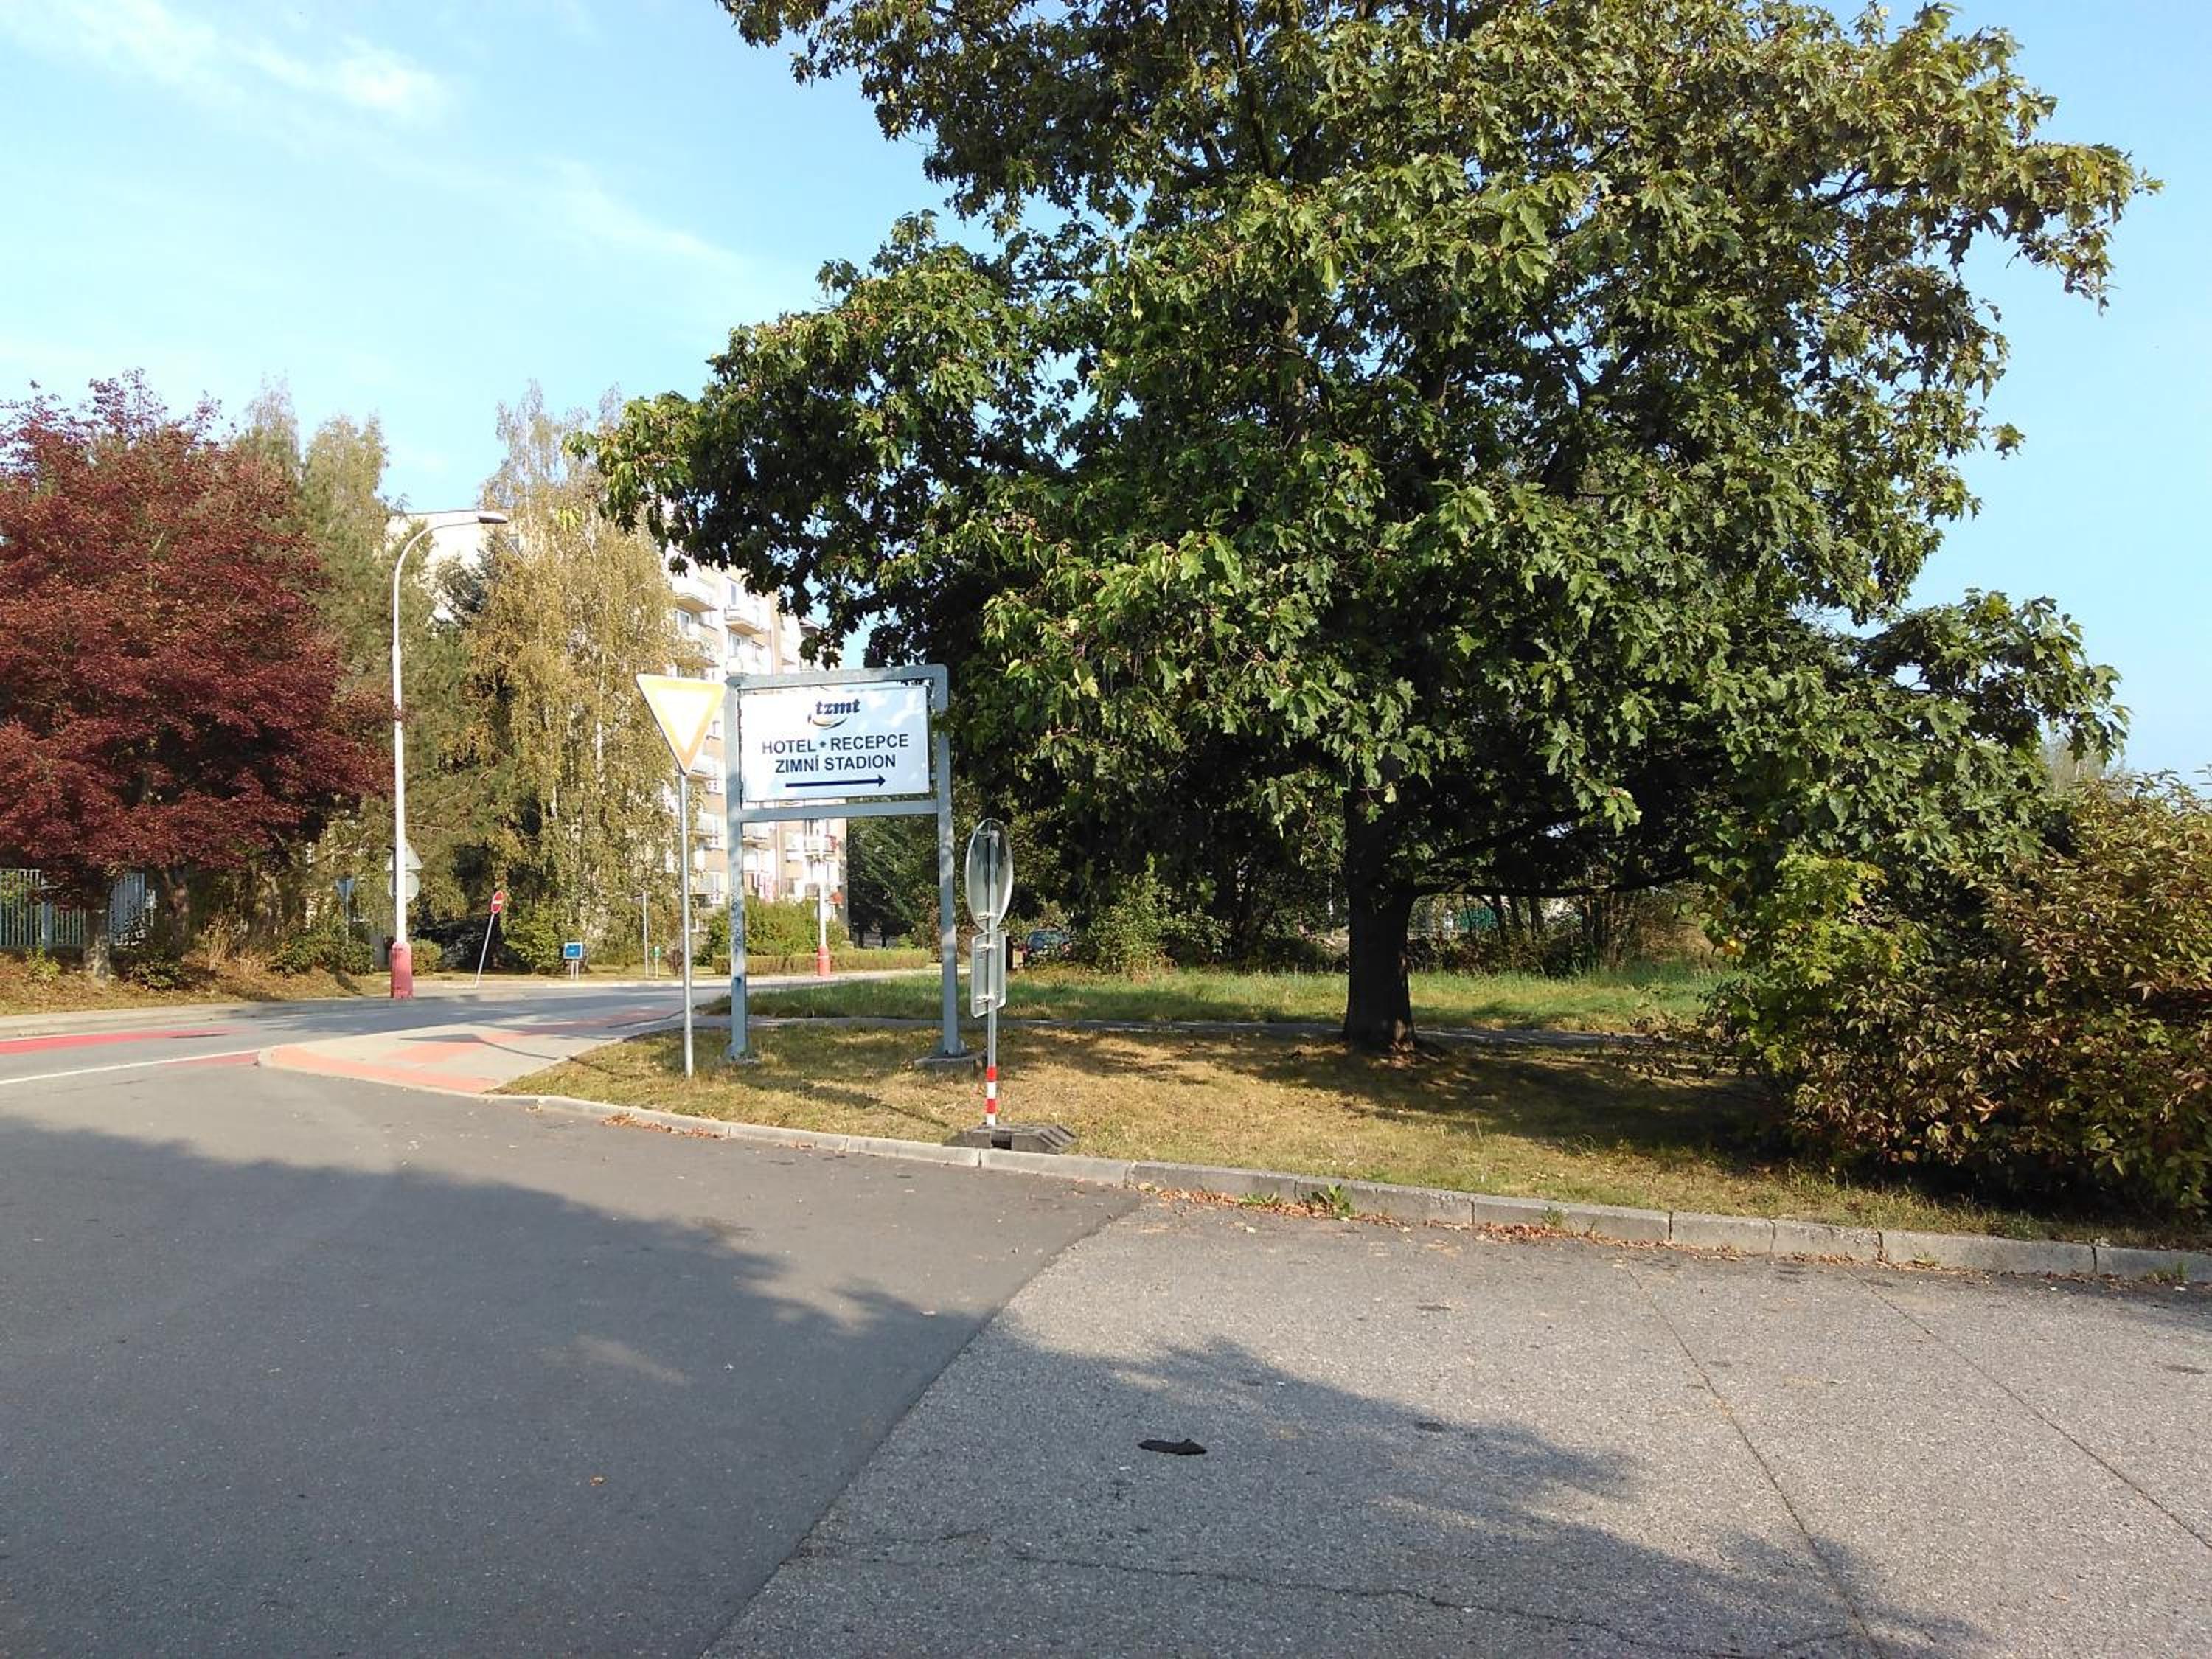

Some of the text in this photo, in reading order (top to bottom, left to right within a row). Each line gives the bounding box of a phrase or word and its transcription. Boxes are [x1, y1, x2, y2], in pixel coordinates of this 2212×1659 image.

[815, 698, 860, 715] tzmt
[762, 734, 909, 754] HOTEL RECEPCE
[775, 754, 896, 773] ZIMNÍ STADION
